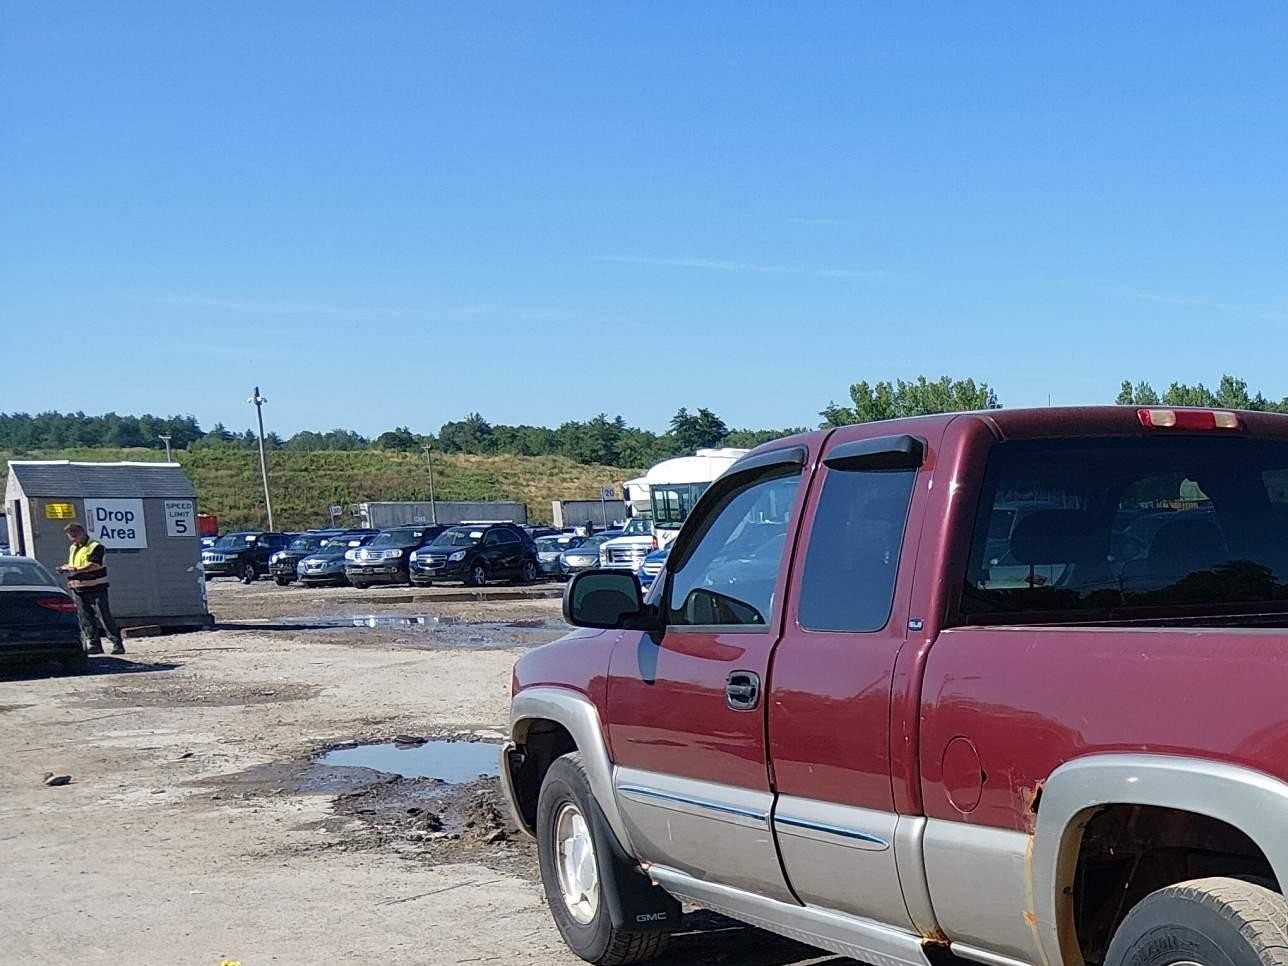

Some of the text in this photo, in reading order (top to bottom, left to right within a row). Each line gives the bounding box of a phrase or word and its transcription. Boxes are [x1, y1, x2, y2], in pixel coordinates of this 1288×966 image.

[96, 507, 134, 524] Drop
[100, 525, 136, 539] Area
[175, 520, 188, 534] 5
[636, 912, 668, 922] GMC
